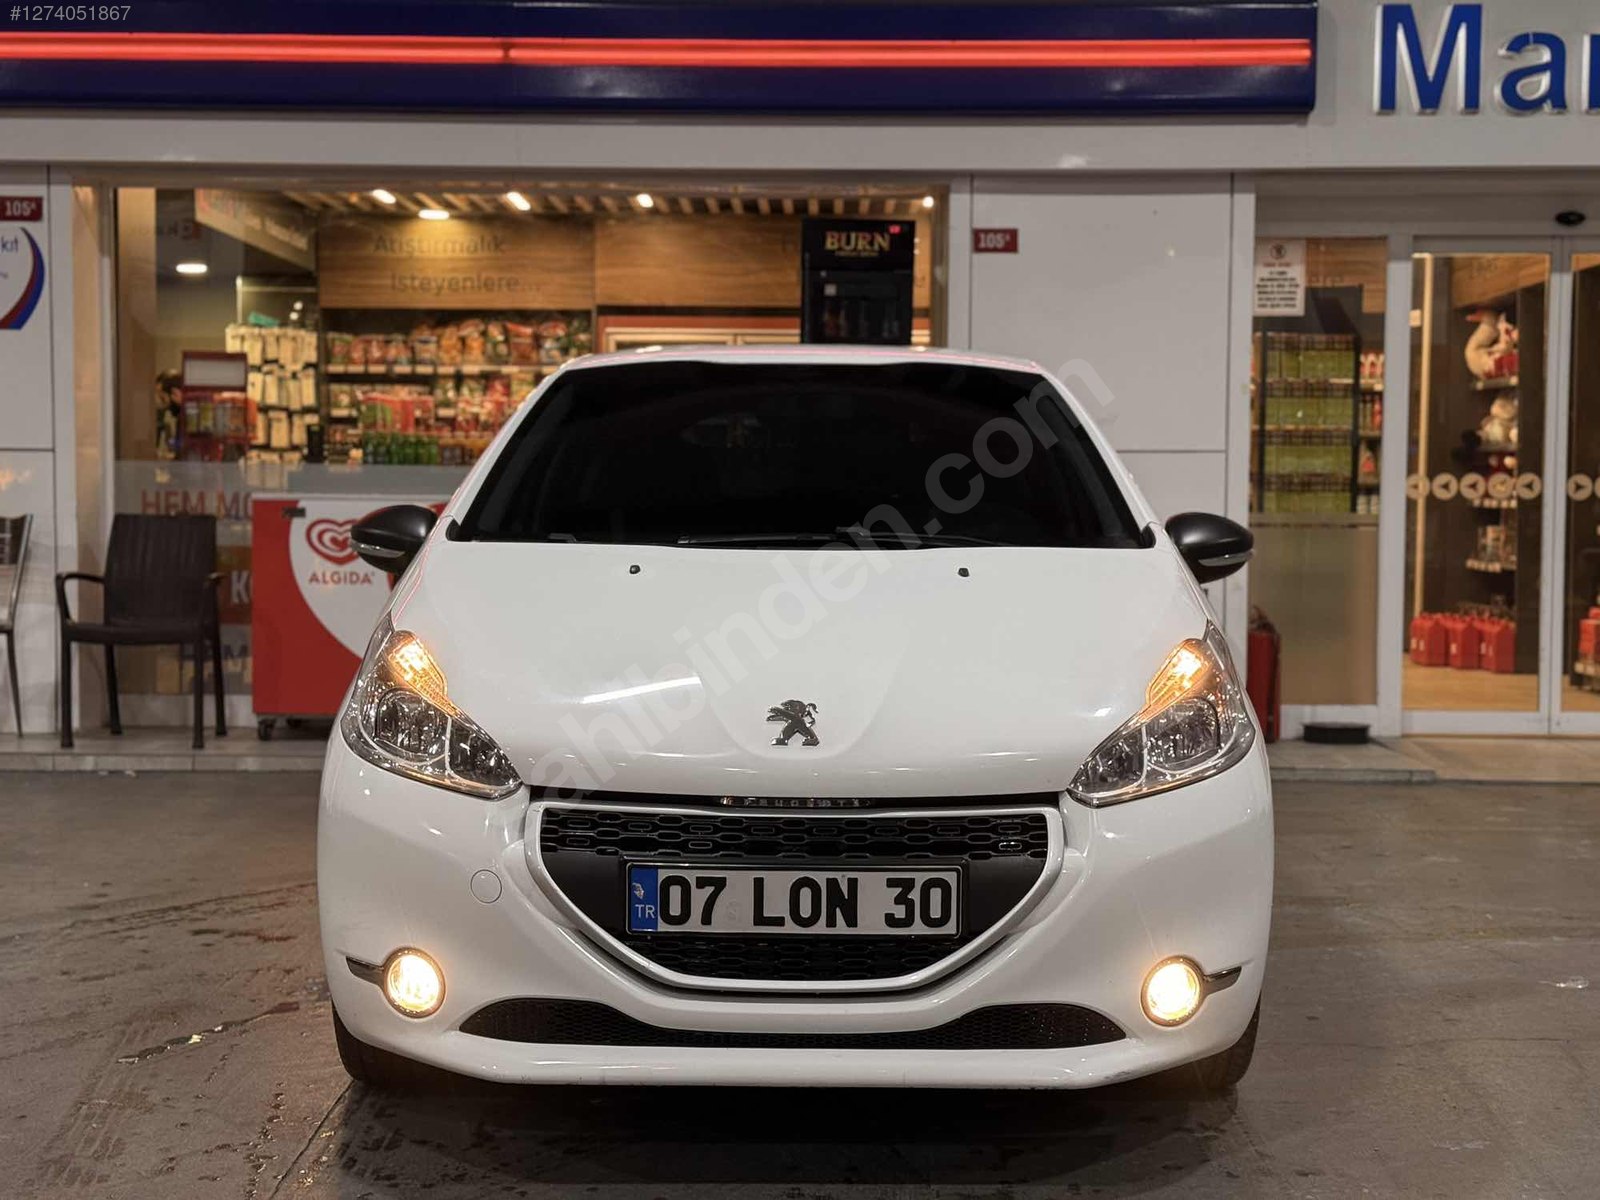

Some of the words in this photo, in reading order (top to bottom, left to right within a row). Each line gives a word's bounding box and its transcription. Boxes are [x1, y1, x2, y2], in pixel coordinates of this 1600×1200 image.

[824, 231, 890, 251] BURN
[308, 570, 373, 585] ALGIDA
[659, 874, 728, 926] 07
[752, 876, 859, 929] LON
[884, 877, 952, 929] 30
[635, 903, 656, 920] TR
